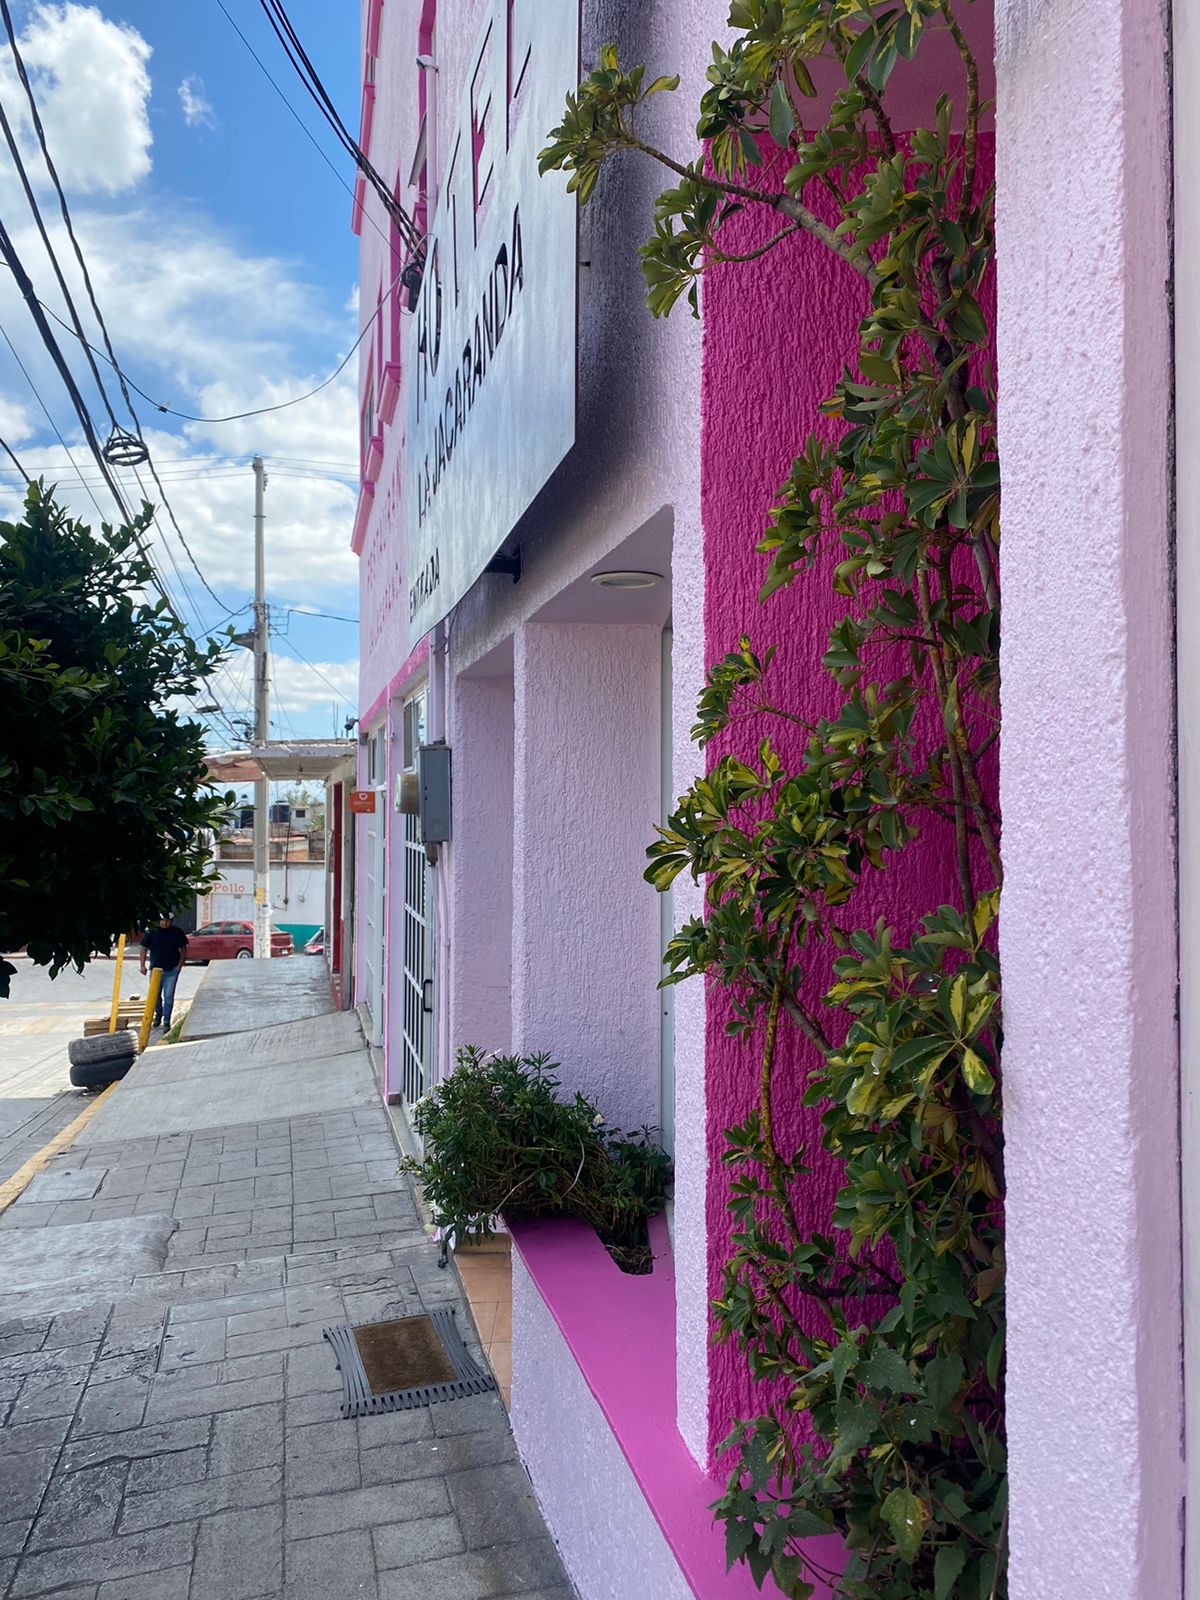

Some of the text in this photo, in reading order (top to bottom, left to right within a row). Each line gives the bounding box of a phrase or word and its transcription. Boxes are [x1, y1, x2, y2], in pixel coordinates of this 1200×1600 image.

[417, 0, 531, 423] HOTEL
[419, 203, 523, 528] LA JACARANDA
[409, 547, 440, 625] ENTRADA
[214, 883, 245, 893] Pollo
